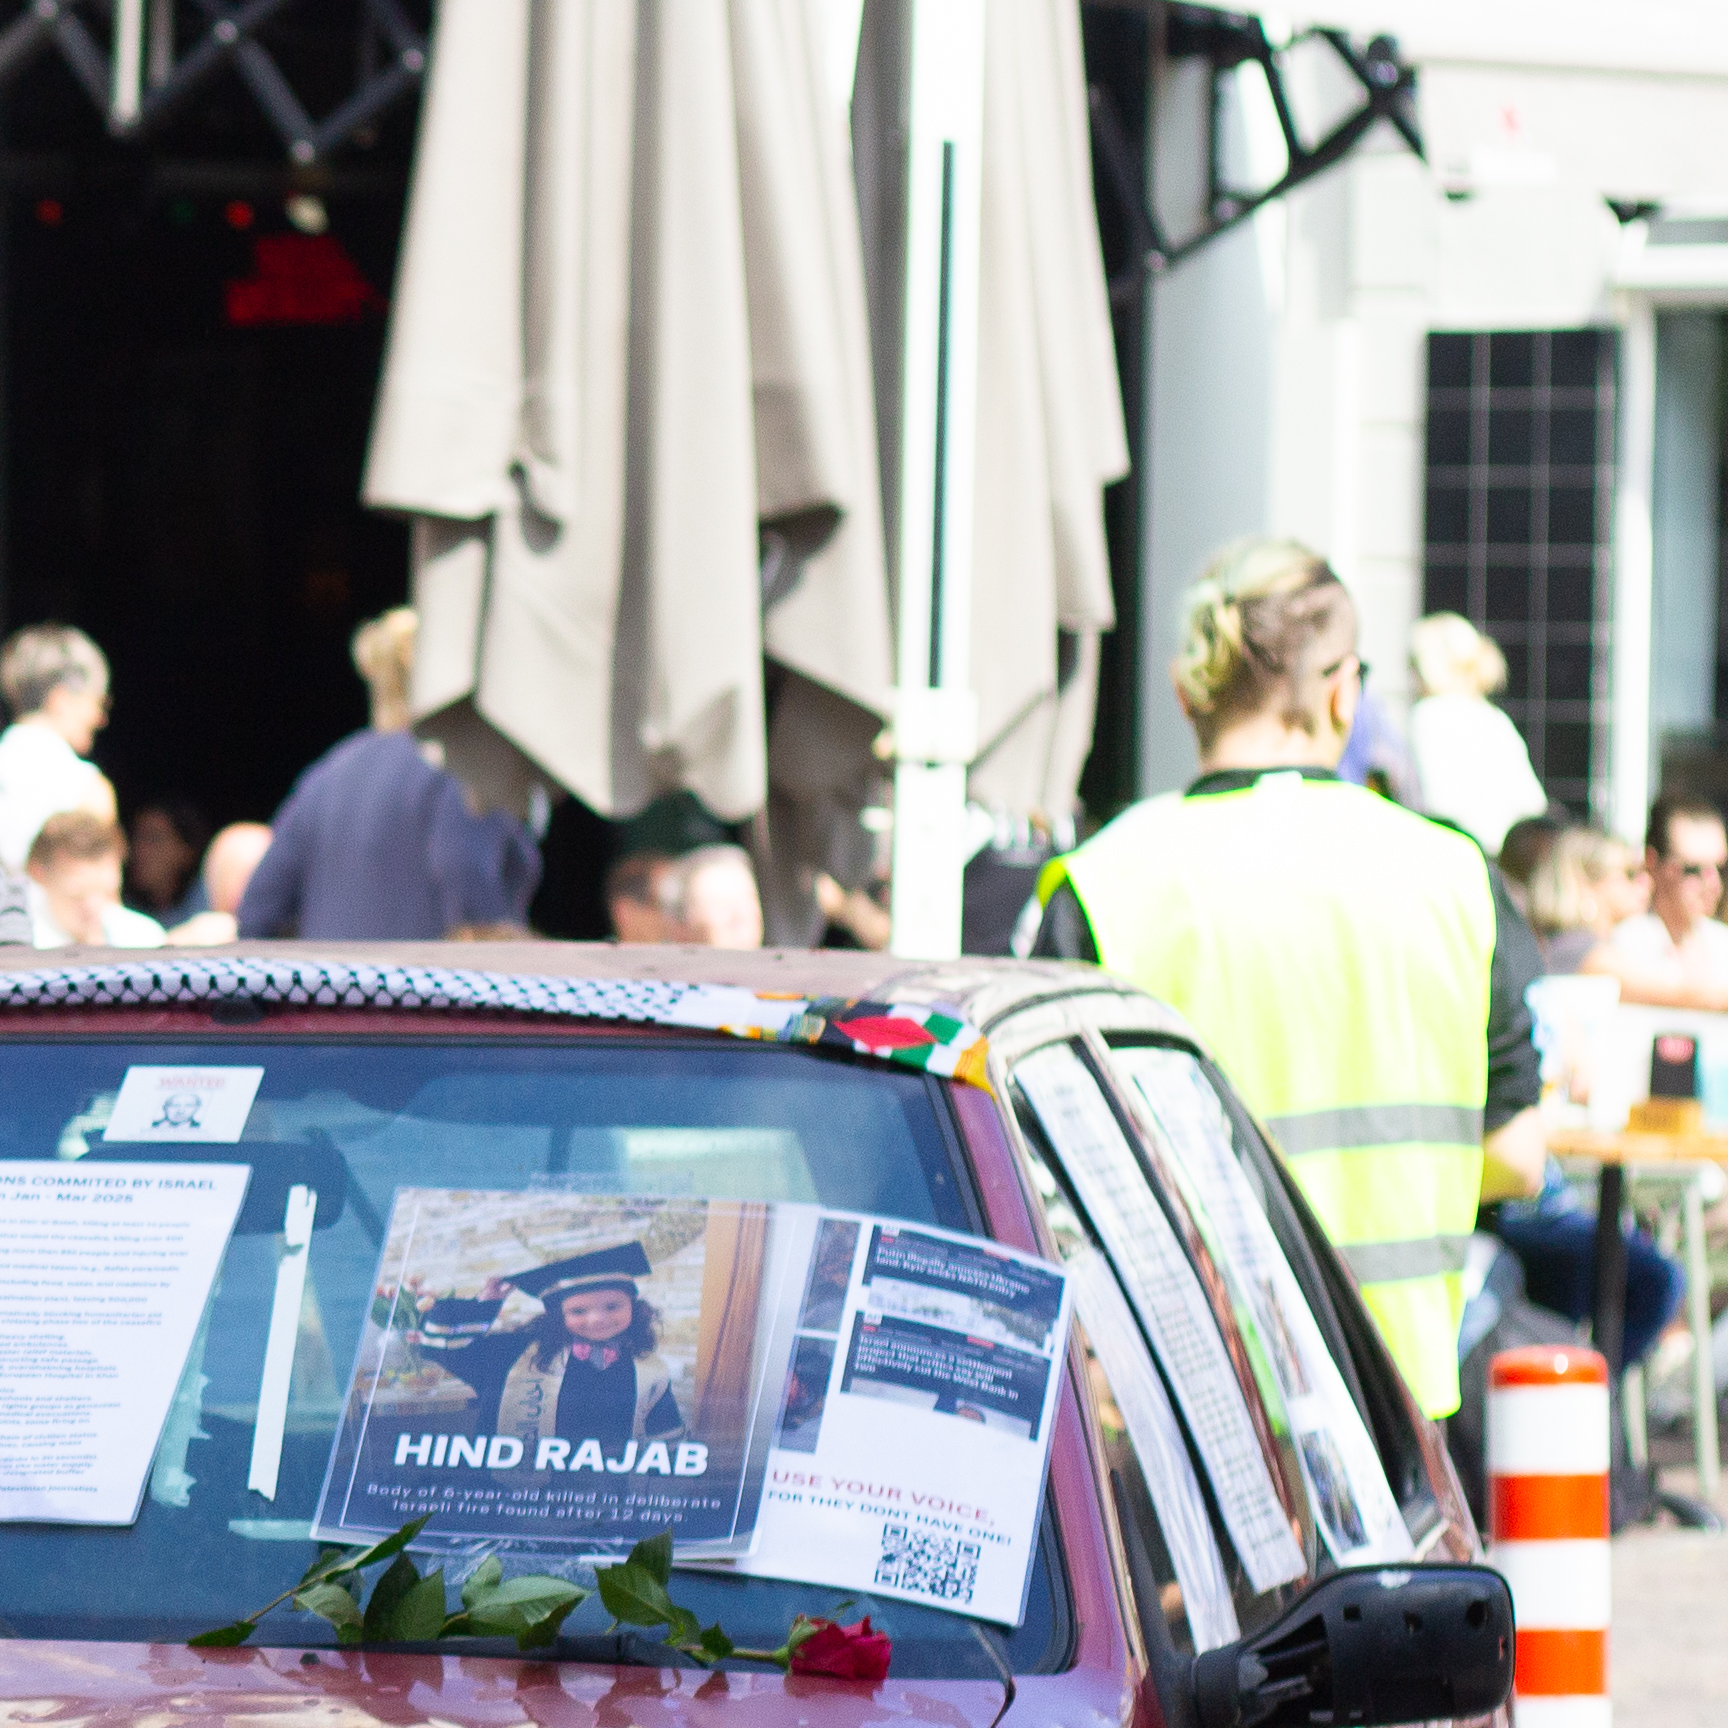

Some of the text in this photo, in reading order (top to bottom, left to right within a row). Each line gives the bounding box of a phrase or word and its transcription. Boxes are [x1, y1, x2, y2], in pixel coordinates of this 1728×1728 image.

[31, 1176, 127, 1188] COMMITED
[132, 1179, 154, 1189] BY
[158, 1179, 217, 1191] ISRAEL
[10, 1192, 41, 1201] Jan
[55, 1192, 87, 1202] Mar
[91, 1192, 134, 1203] 2025
[879, 1247, 905, 1260] Putin
[992, 1270, 1030, 1293] Ukraine
[958, 1274, 986, 1288] NATO
[899, 1351, 918, 1364] that
[393, 1432, 709, 1476] HIND RAJAB
[367, 1483, 721, 1510] Body of 6-year-old killed in deliberate
[773, 1469, 995, 1527] USE YOUR VOICE,
[393, 1499, 689, 1525] Israeli fire found after 12 days.
[768, 1490, 1012, 1547] FOR THEY DONT HAVE ONE!
